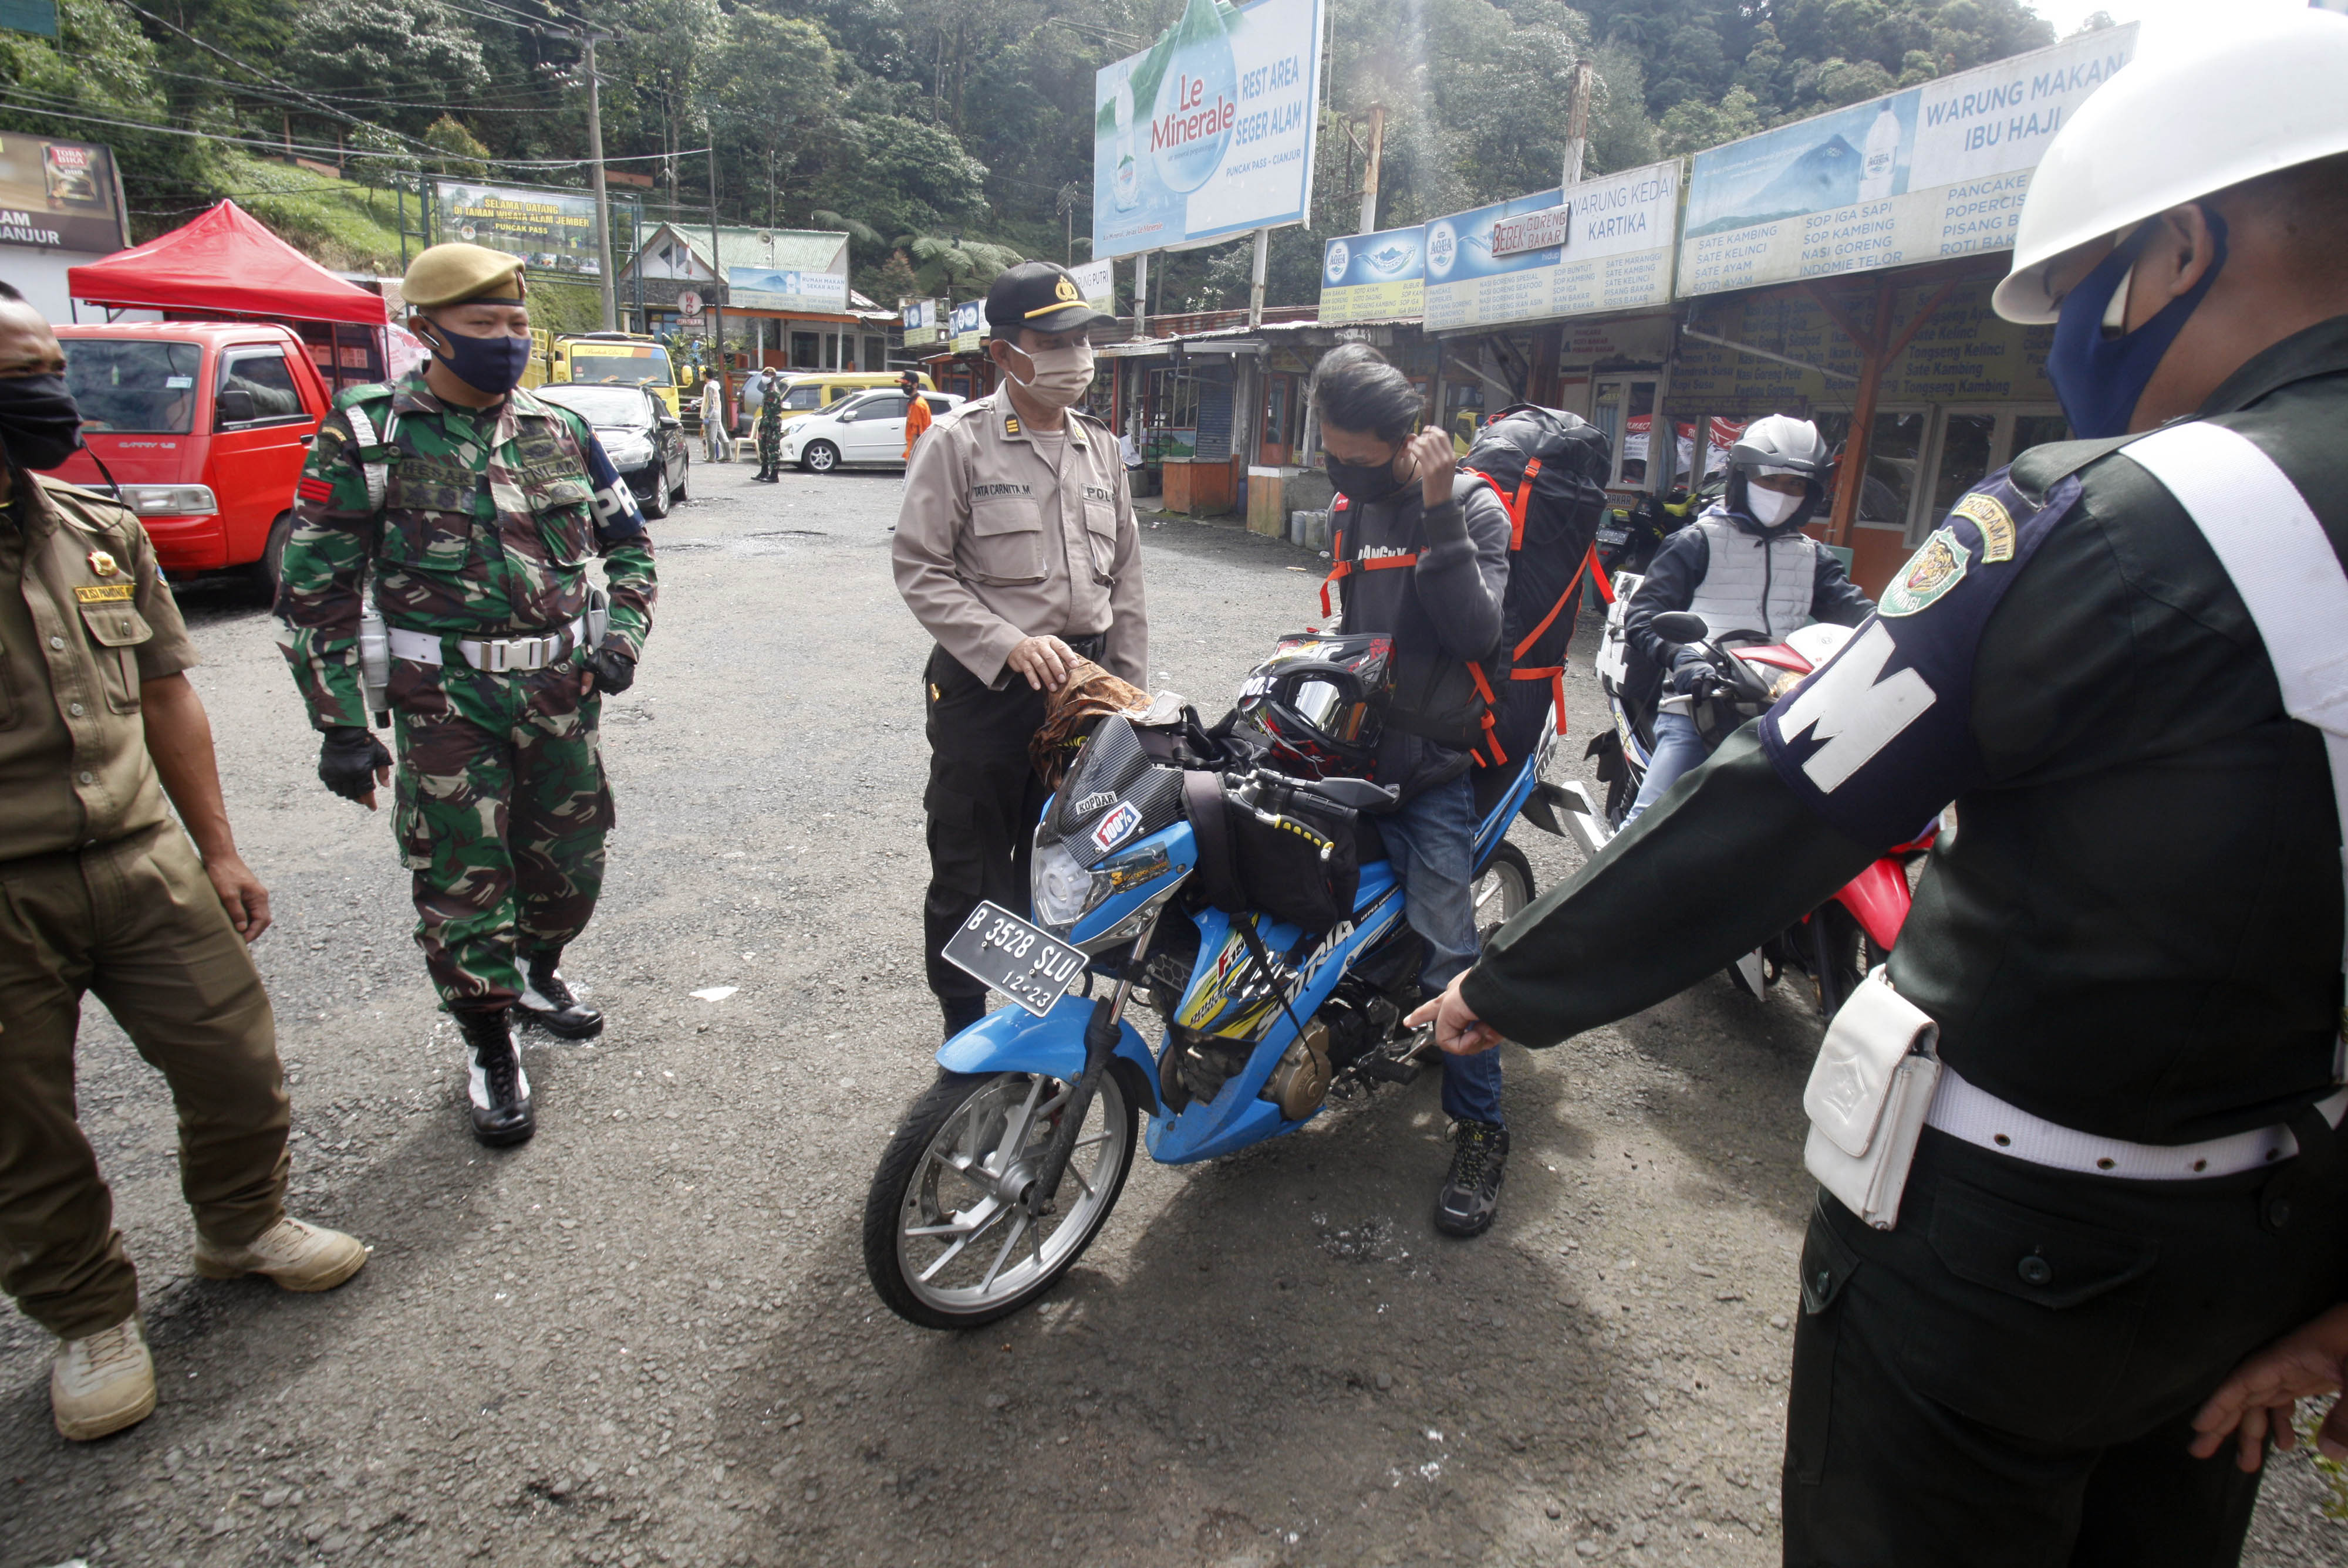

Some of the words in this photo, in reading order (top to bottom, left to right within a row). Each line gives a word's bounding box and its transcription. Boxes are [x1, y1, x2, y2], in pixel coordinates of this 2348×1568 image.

[1243, 66, 1267, 102] REST
[1269, 55, 1298, 92] AREA
[1180, 74, 1203, 111] Le
[1927, 80, 2024, 127] WARUNG
[2030, 52, 2124, 100] MAKAN
[1150, 94, 1234, 153] Minerale
[1236, 111, 1268, 146] SEGER
[1270, 100, 1301, 136] ALAM
[1964, 121, 2001, 152] IBU
[2007, 106, 2062, 142] HAJI
[55, 148, 83, 158] TORA
[58, 156, 84, 165] BIKA
[1226, 163, 1250, 177] PUNCAK
[1251, 158, 1267, 171] PASS
[1273, 149, 1301, 165] CIANJUR
[1948, 174, 2027, 201] PANCAKE
[1569, 187, 1627, 217] WARUNG
[1631, 176, 1674, 204] KEDAI
[485, 198, 524, 211] SELAMAT
[525, 201, 559, 215] DATANG
[1945, 193, 2027, 219] POPERCIS
[454, 205, 463, 215] DI
[465, 207, 494, 218] TAMAN
[497, 210, 528, 221] WISATA
[529, 213, 554, 224] ALAM
[556, 215, 590, 228] JEMBER
[1806, 214, 1831, 229] SOP
[1834, 208, 1857, 224] IGA
[1861, 202, 1892, 218] SAPI
[495, 222, 527, 233] PUNCAK
[529, 226, 548, 235] PASS
[1126, 229, 1137, 237] Jelas
[1492, 223, 1526, 253] BEBEK
[1527, 211, 1566, 231] GORENG
[1588, 212, 1647, 241] KARTIKA
[1803, 231, 1830, 245] SOP
[1832, 218, 1895, 239] KAMBING
[1942, 216, 2002, 238] PISANG
[1430, 237, 1453, 254] AQUA
[1528, 229, 1561, 249] BAKAR
[1698, 238, 1724, 251] SATE
[1726, 225, 1777, 244] KAMBING
[1696, 253, 1722, 265] SATE
[1724, 244, 1767, 259] KELINCI
[1801, 246, 1831, 261] NASI
[1834, 236, 1892, 256] GORENG
[1939, 239, 1977, 256] ROTI
[1330, 253, 1345, 265] AQUA
[1541, 252, 1560, 261] hidup
[1606, 259, 1623, 268] SATE
[1624, 253, 1662, 265] MARANGGI
[1799, 259, 1853, 278] INDOMIE
[1858, 251, 1902, 268] TELOR
[1092, 269, 1109, 285] PUTRI
[1554, 268, 1566, 276] SOP
[1567, 265, 1593, 275] BUNTUT
[1605, 269, 1622, 278] SATE
[1624, 263, 1656, 275] KAMBING
[1695, 268, 1720, 279] SATE
[1723, 260, 1753, 273] AYAM
[1492, 286, 1516, 295] GORENG
[1516, 281, 1543, 292] SEAFOOD
[1493, 277, 1516, 286] GORENG
[1516, 273, 1539, 283] SPESIAL
[1553, 278, 1566, 286] SOP
[1567, 273, 1596, 283] KAMBING
[1605, 279, 1622, 288] SATE
[1623, 275, 1650, 285] KELINCI
[1692, 281, 1720, 294] SOTO
[1723, 275, 1753, 288] AYAM
[1365, 293, 1383, 302] DAGING
[1552, 296, 1567, 304] IKAN
[1568, 292, 1590, 302] BAKAR
[1604, 287, 1629, 296] PISANG
[1630, 283, 1655, 293] BAKAR
[1376, 300, 1396, 308] KAMBING
[1492, 295, 1515, 303] GORENG
[1492, 303, 1515, 311] GORENG
[1551, 304, 1571, 313] BEBEK
[1573, 301, 1595, 310] BAKAR
[1603, 298, 1623, 306] SOSIS
[1625, 295, 1649, 304] BAKAR
[1492, 311, 1514, 319] GORENG
[1938, 325, 1978, 340] Kelinci
[1705, 353, 1722, 363] Tea
[1909, 344, 1961, 361] Tongseng
[1964, 342, 2006, 357] Kelinci
[1736, 369, 1754, 380] Nasi
[1755, 369, 1782, 383] Goreng
[1905, 363, 1930, 376] Sate
[1932, 361, 1984, 377] Kambing
[1904, 381, 1956, 397] Tongseng
[1958, 379, 2011, 396] Kambing
[521, 462, 578, 484] TNI-AD
[973, 485, 989, 497] TATA
[1607, 494, 1631, 505] BAKAR
[1079, 792, 1115, 813] KOPDAR
[1101, 806, 1133, 842] 100%
[1360, 904, 1378, 922] HYPER
[967, 909, 988, 931] B
[985, 917, 1035, 959] 3528
[1033, 945, 1077, 983] SLU
